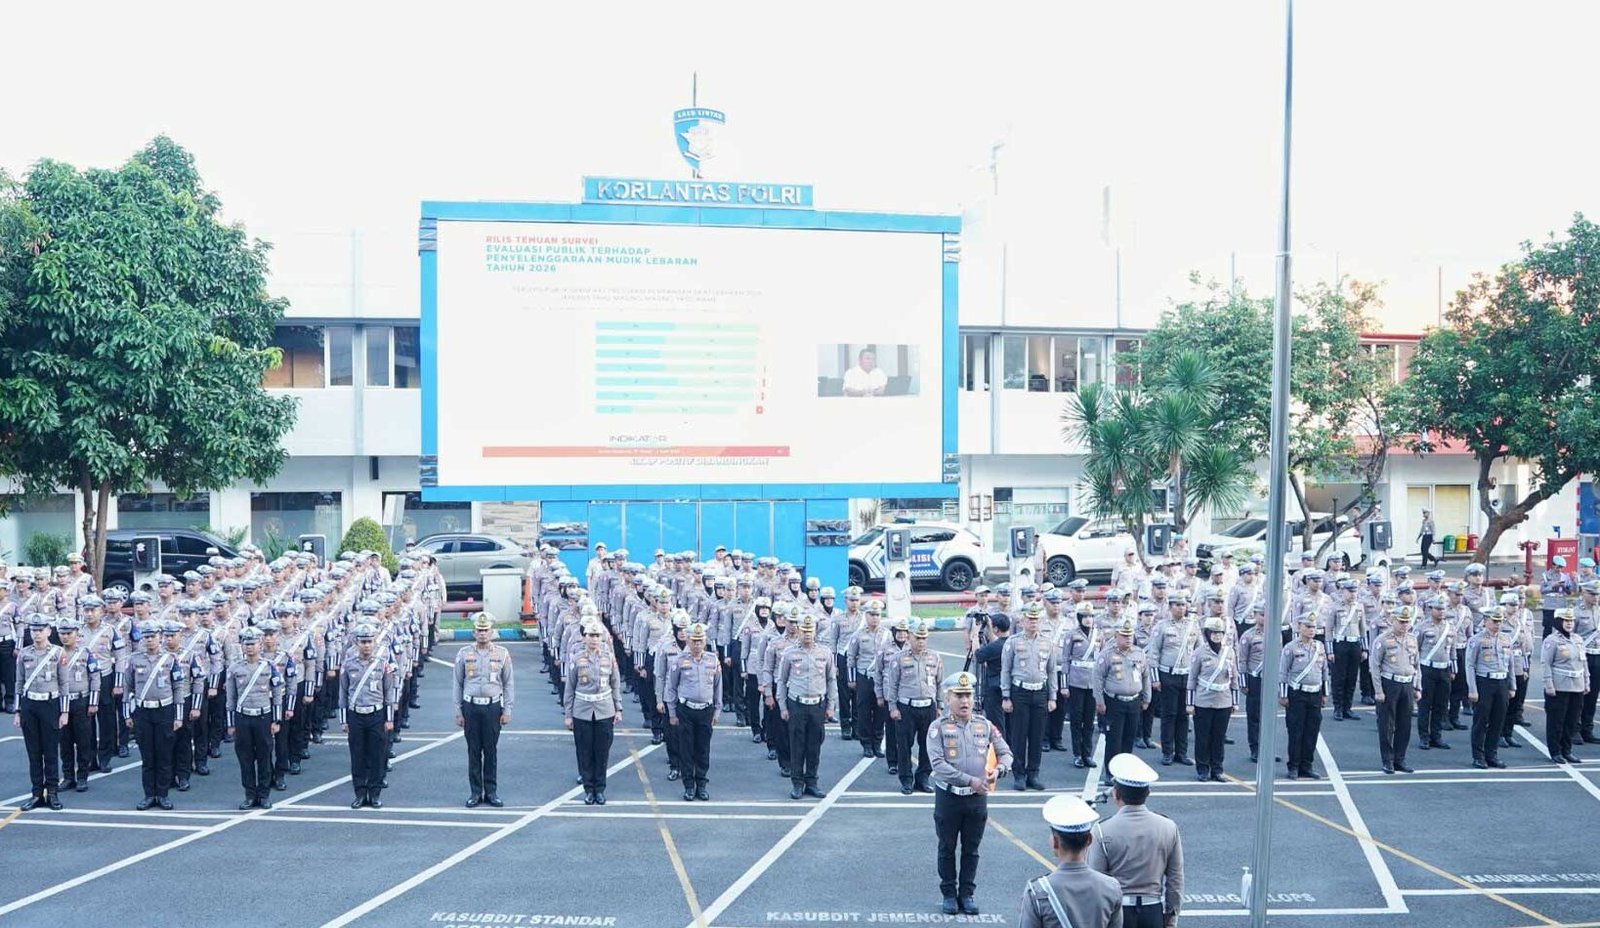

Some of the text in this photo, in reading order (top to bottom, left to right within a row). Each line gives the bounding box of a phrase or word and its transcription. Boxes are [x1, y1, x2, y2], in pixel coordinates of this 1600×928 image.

[597, 181, 801, 204] KORLANTAS POLRI
[486, 235, 599, 245] RILIS TEMUAN SURVEI
[486, 245, 651, 255] EVALUASI PUBLIK TERHADAP
[486, 254, 698, 265] PENYELENGGARAAN MUDIK LEBARAN
[486, 264, 525, 272] TAHUN
[430, 911, 617, 927] KASUBDIT STANDAR
[766, 911, 861, 922] KASUBDIT
